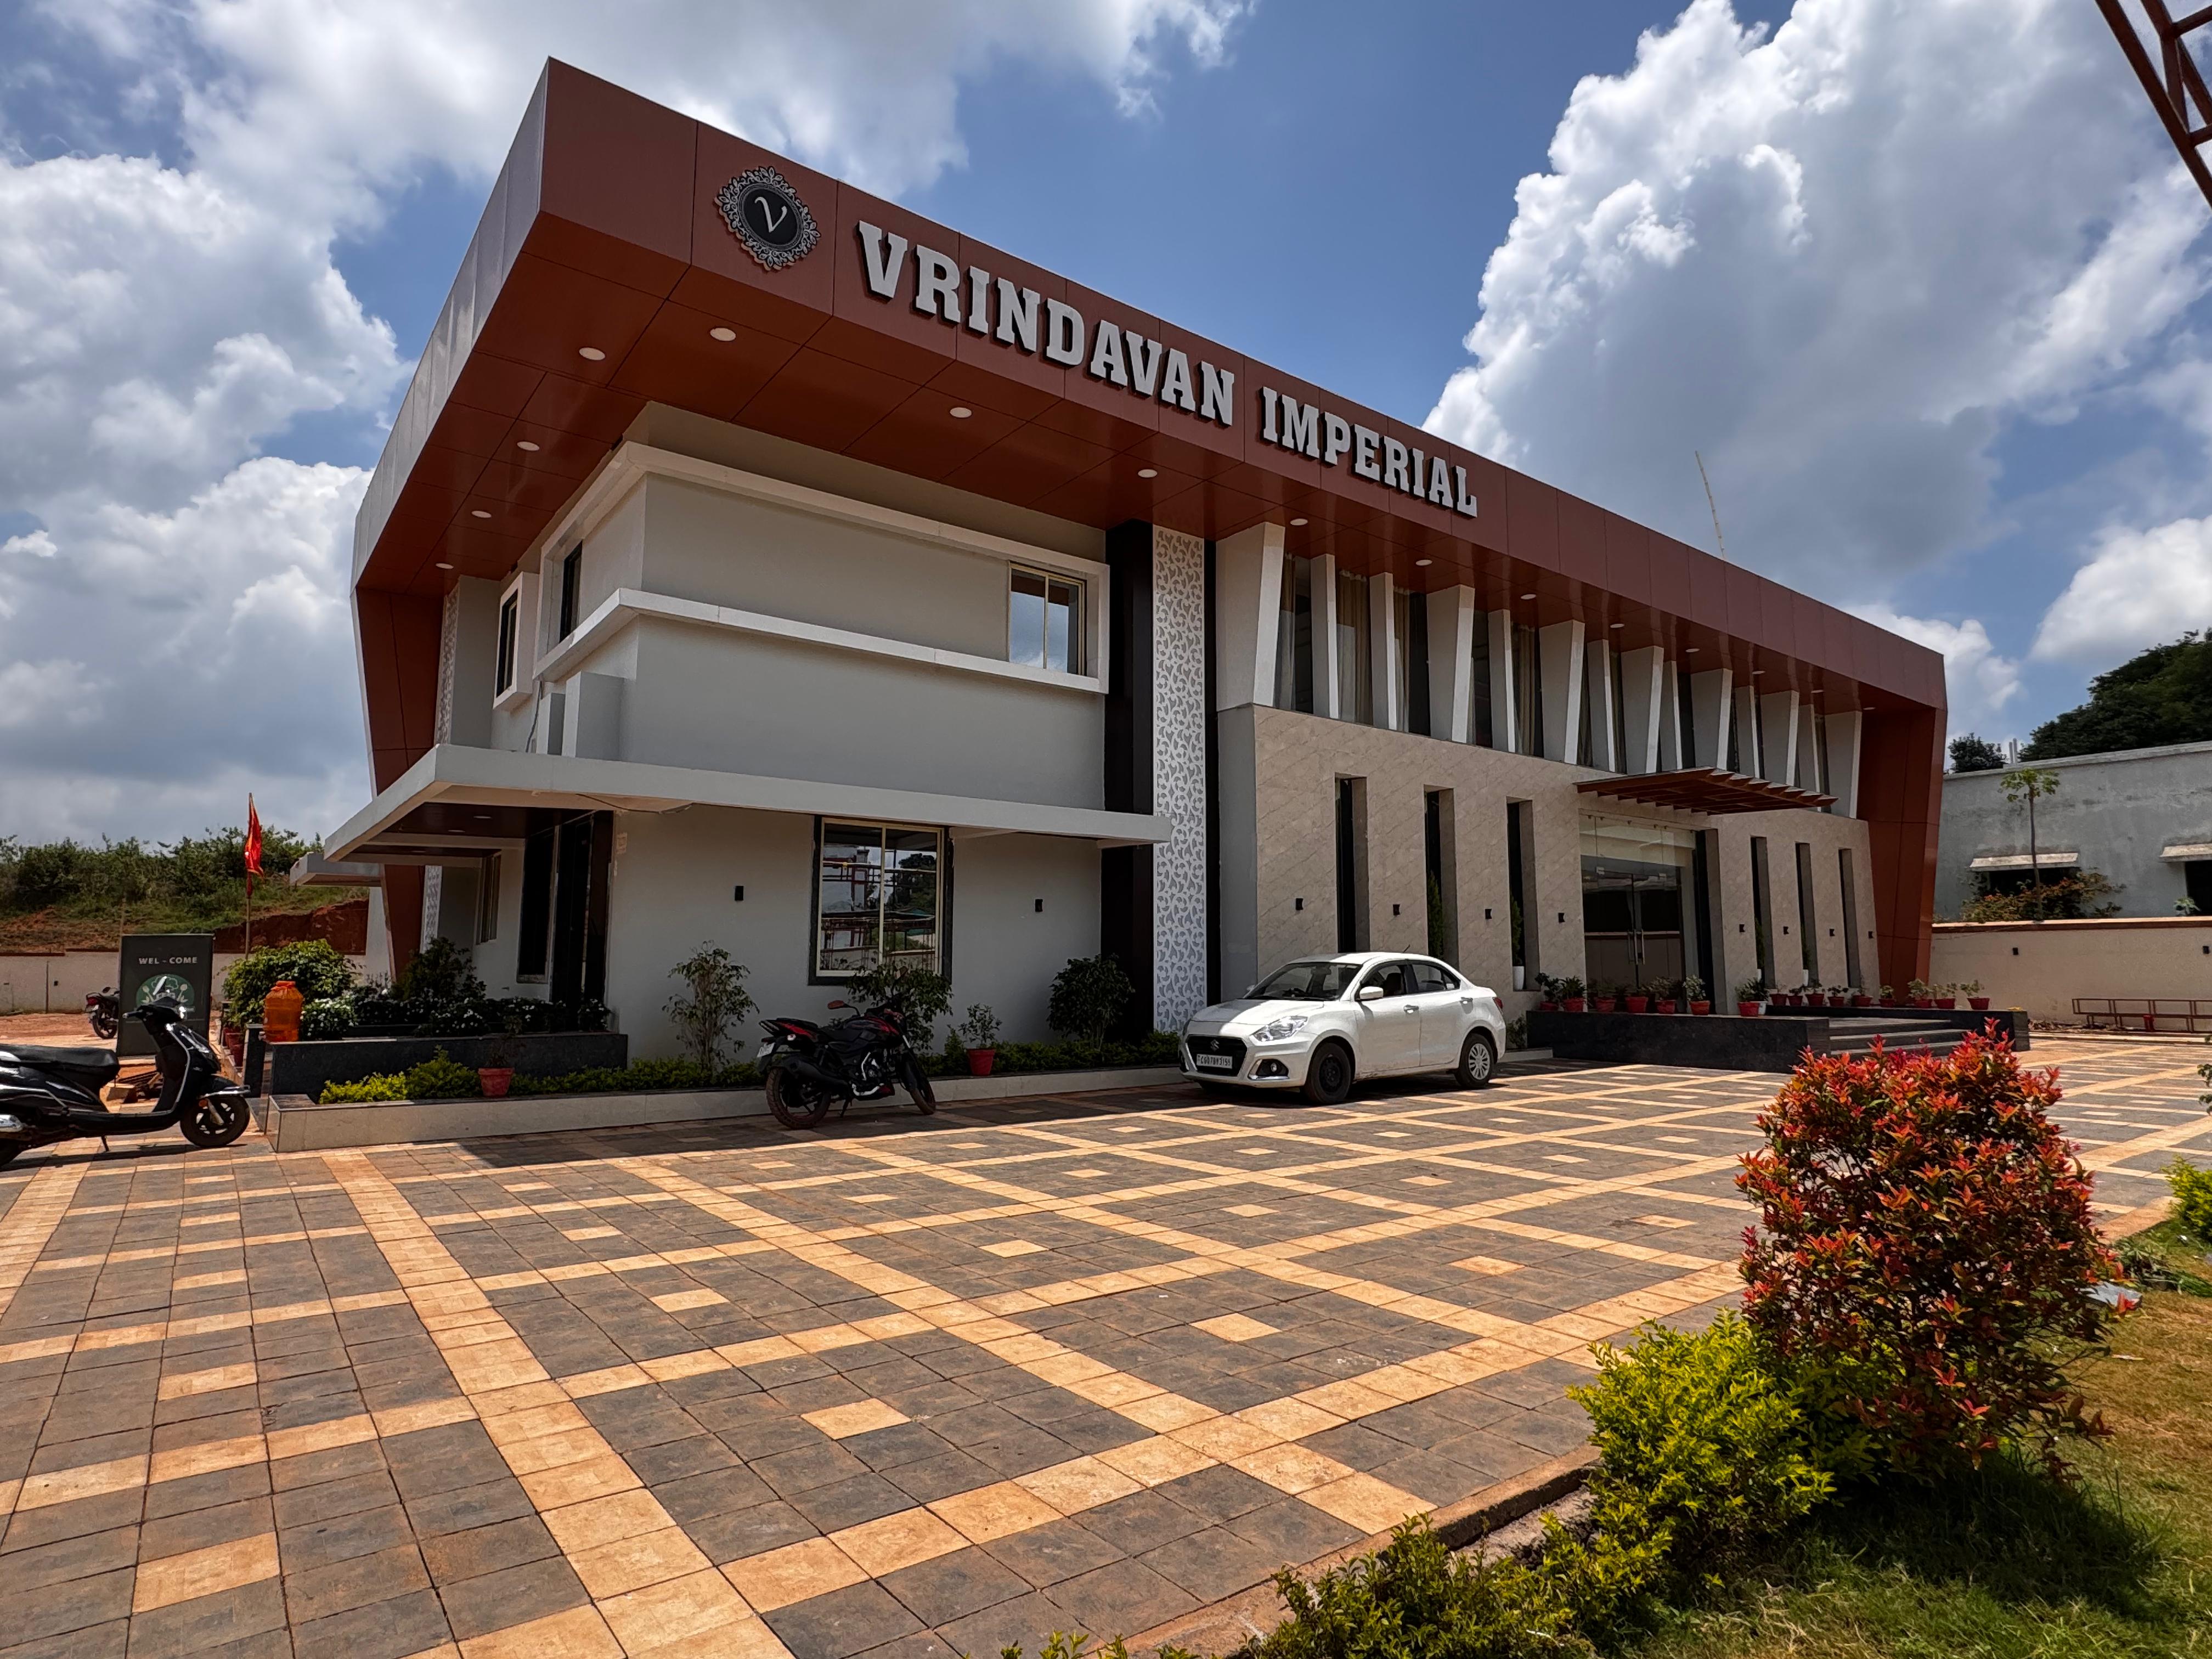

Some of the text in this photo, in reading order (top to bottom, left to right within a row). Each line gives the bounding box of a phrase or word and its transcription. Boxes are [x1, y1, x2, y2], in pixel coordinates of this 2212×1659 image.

[754, 196, 788, 233] V
[858, 219, 1478, 518] VRINDAVAN IMPERIAL
